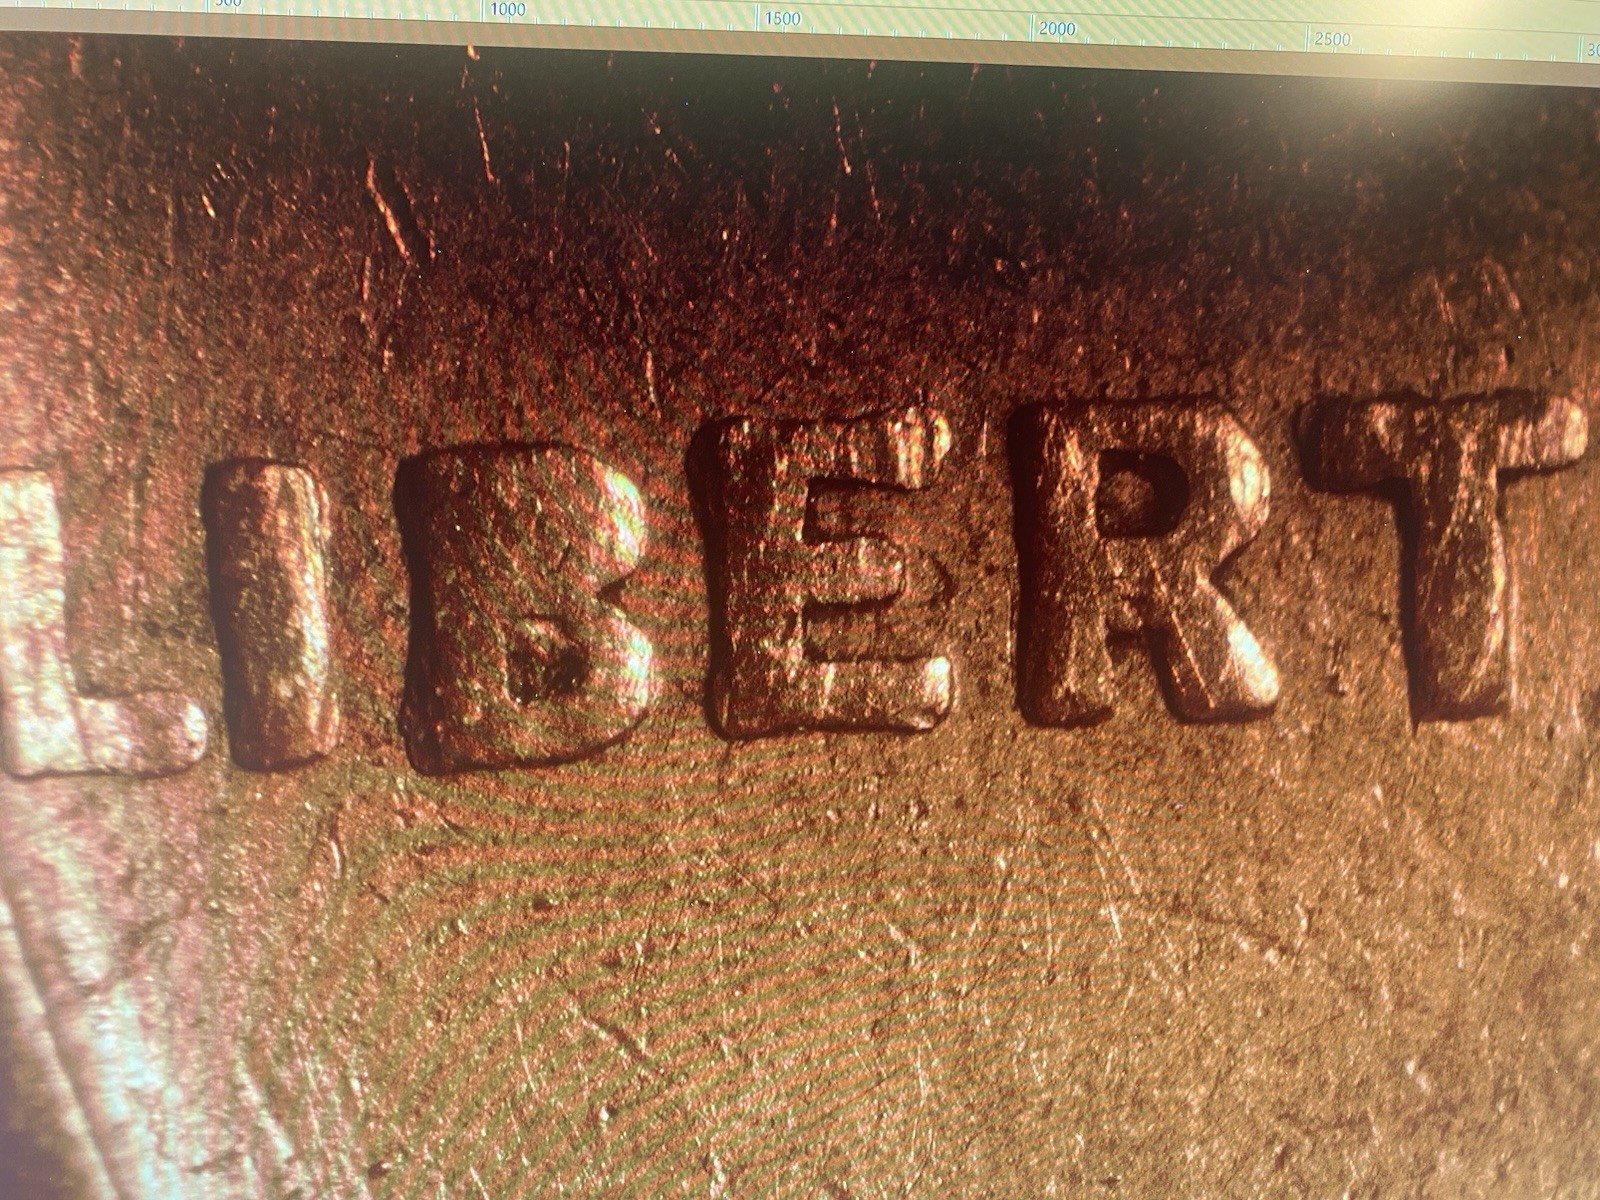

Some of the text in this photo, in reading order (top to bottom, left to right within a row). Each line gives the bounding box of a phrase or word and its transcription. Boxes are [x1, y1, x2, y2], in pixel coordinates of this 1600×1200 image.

[490, 2, 526, 16] 1000
[765, 11, 801, 26] 1500
[1039, 21, 1076, 36] 2000
[1314, 31, 1351, 46] 2500
[0, 389, 1588, 777] LIBERT
